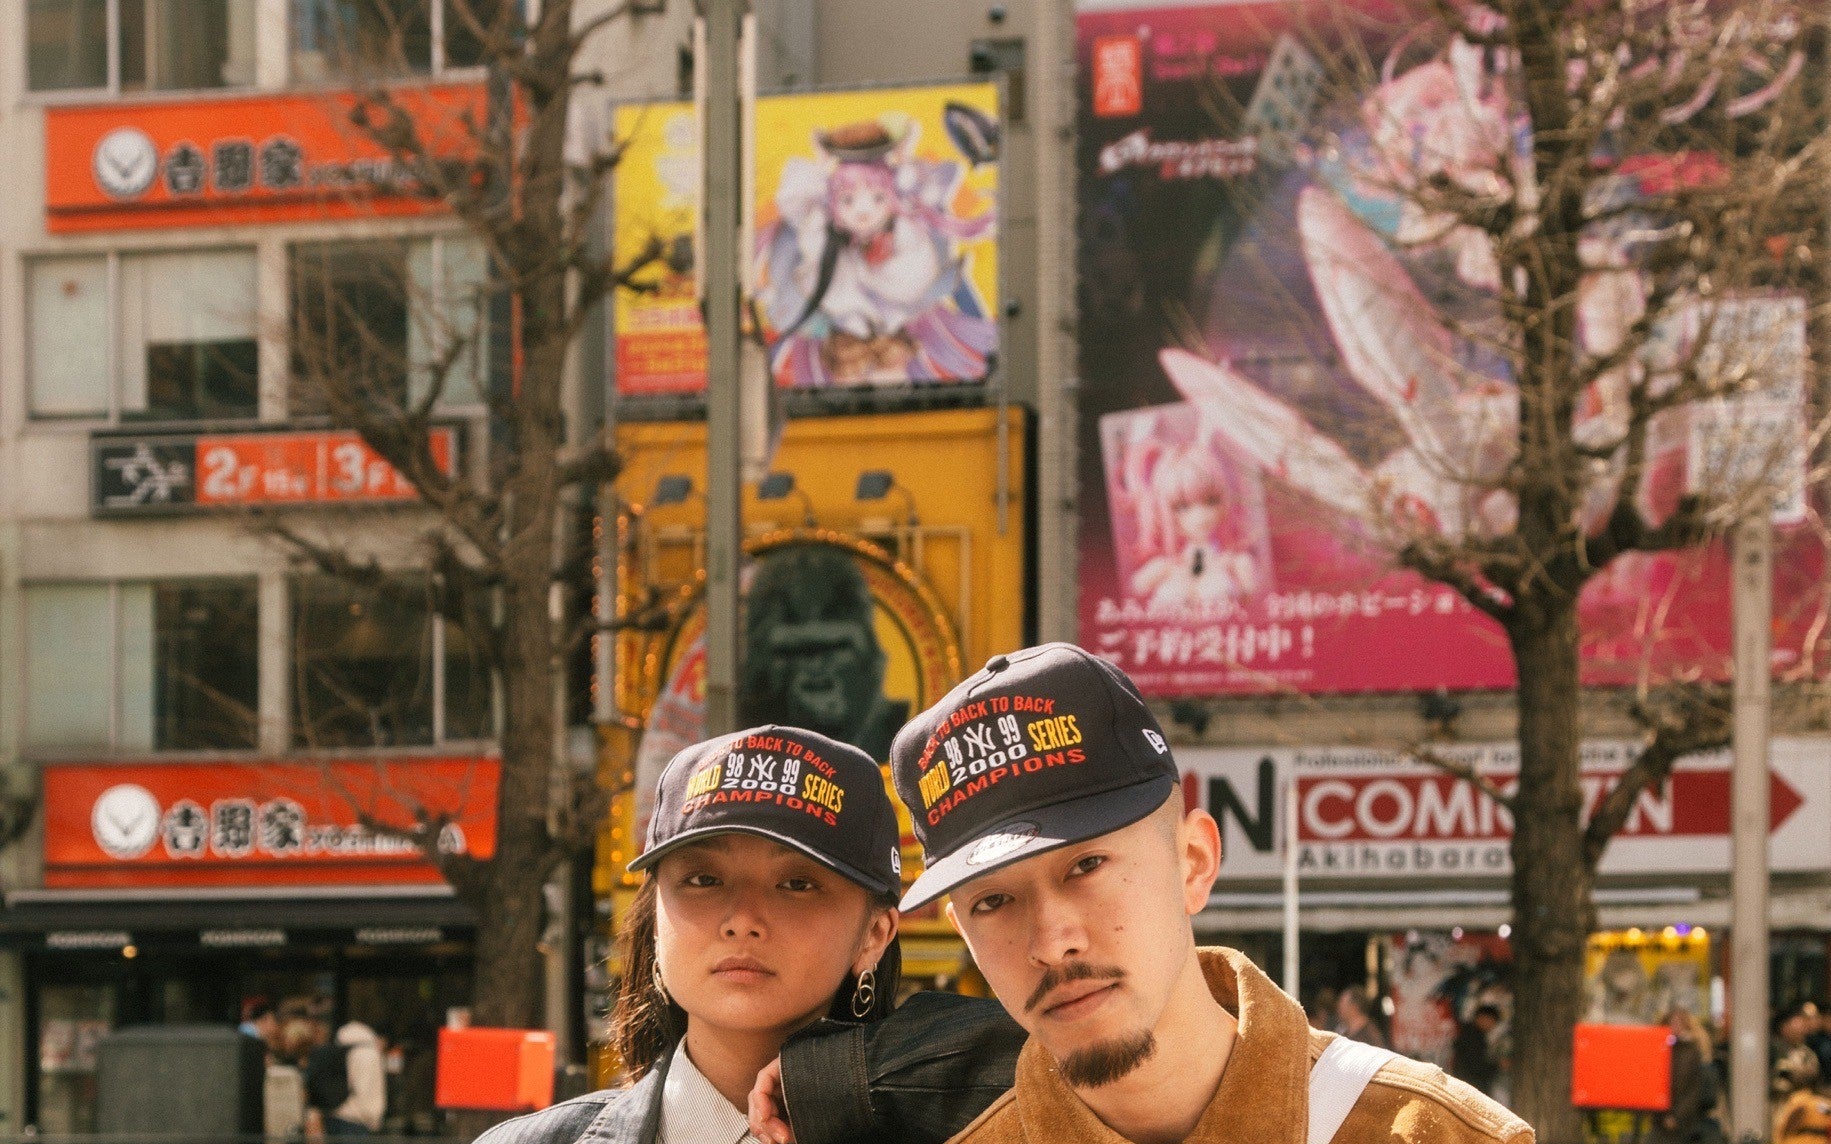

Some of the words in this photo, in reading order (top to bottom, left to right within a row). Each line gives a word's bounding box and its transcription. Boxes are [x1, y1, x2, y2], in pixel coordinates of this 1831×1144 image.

[950, 700, 992, 729] BACK
[990, 695, 1010, 714] TO
[1013, 695, 1056, 715] BACK
[747, 735, 783, 751] BACK
[785, 741, 804, 757] TO
[802, 750, 838, 779] BACK
[918, 760, 951, 810] WORLD
[952, 743, 1028, 787] 2000
[1027, 714, 1083, 752] SERIES
[943, 736, 965, 769] 98
[998, 714, 1022, 746] 99
[685, 764, 722, 801] WORLD
[721, 777, 797, 796] 2000
[802, 773, 846, 814] SERIES
[726, 753, 745, 778] 98
[781, 758, 801, 785] 99
[927, 748, 1087, 827] CHAMPIONS
[164, 799, 305, 857] 吉野家
[681, 790, 838, 827] CHAMPIONS
[1298, 845, 1507, 870] Akihabara
